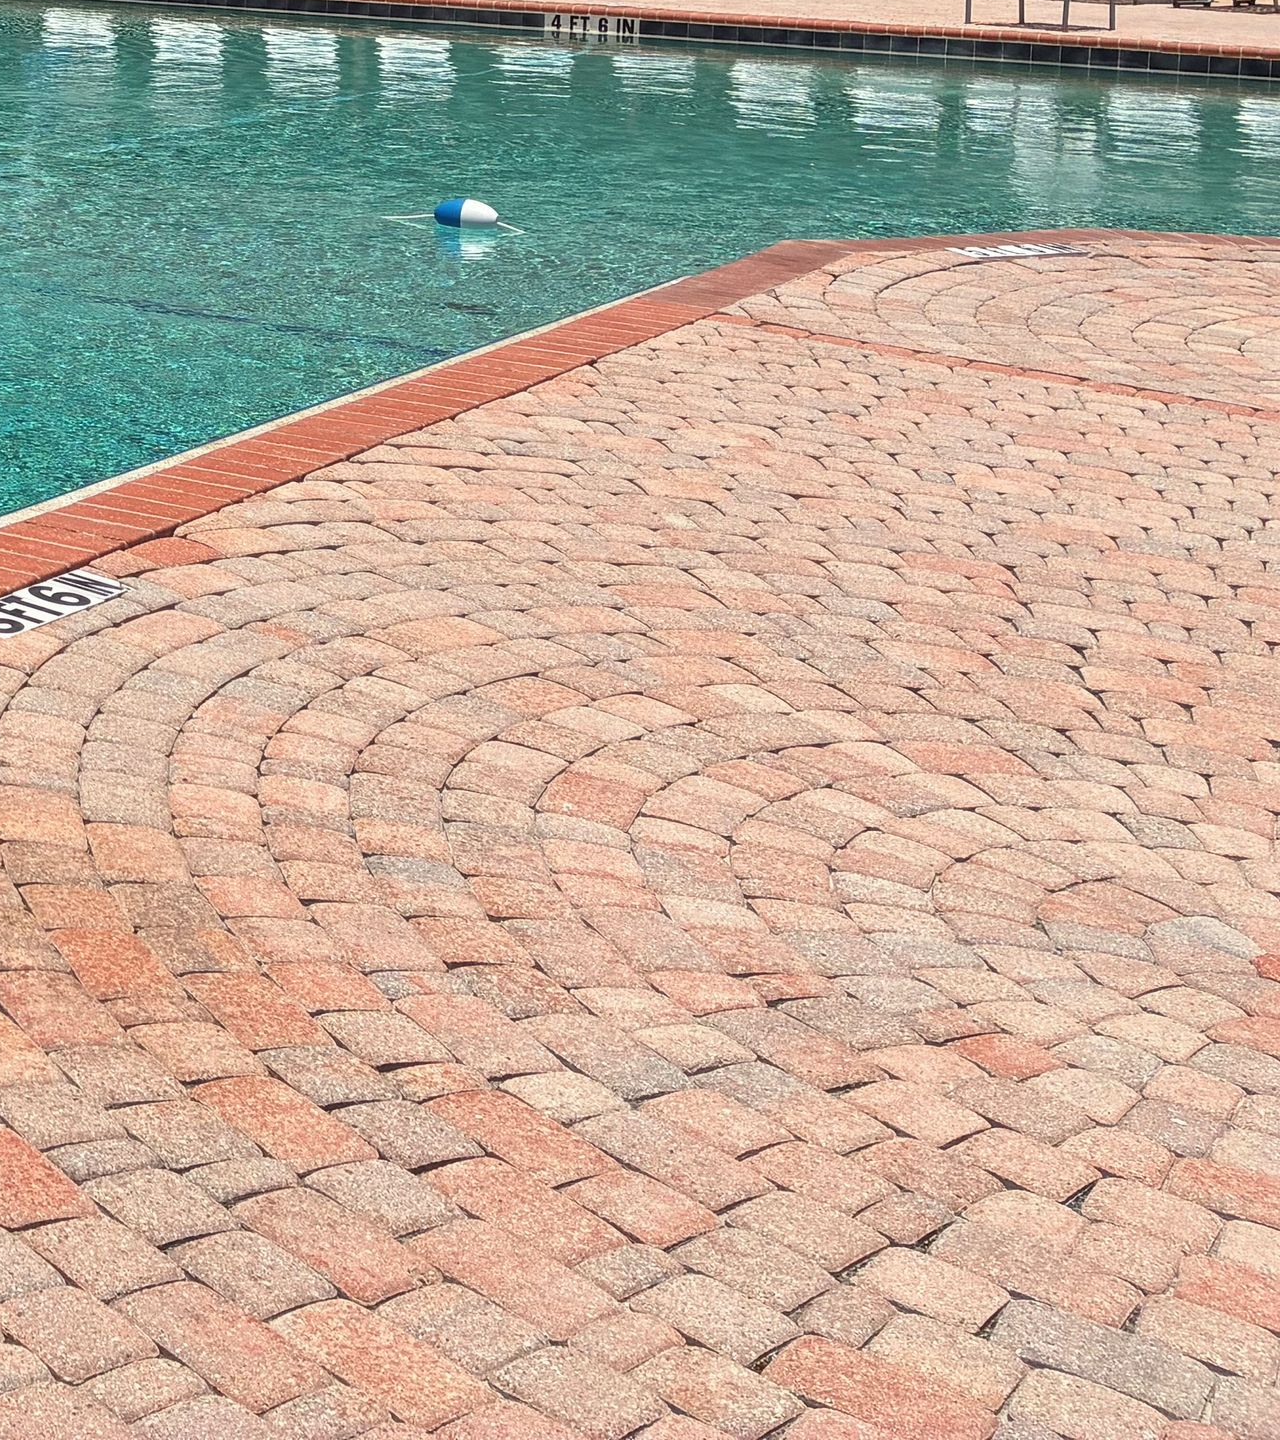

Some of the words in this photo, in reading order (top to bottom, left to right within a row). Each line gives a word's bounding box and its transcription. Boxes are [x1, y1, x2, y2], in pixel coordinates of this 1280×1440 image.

[551, 14, 562, 30] 4
[598, 17, 609, 33] 6
[28, 585, 92, 607] 6
